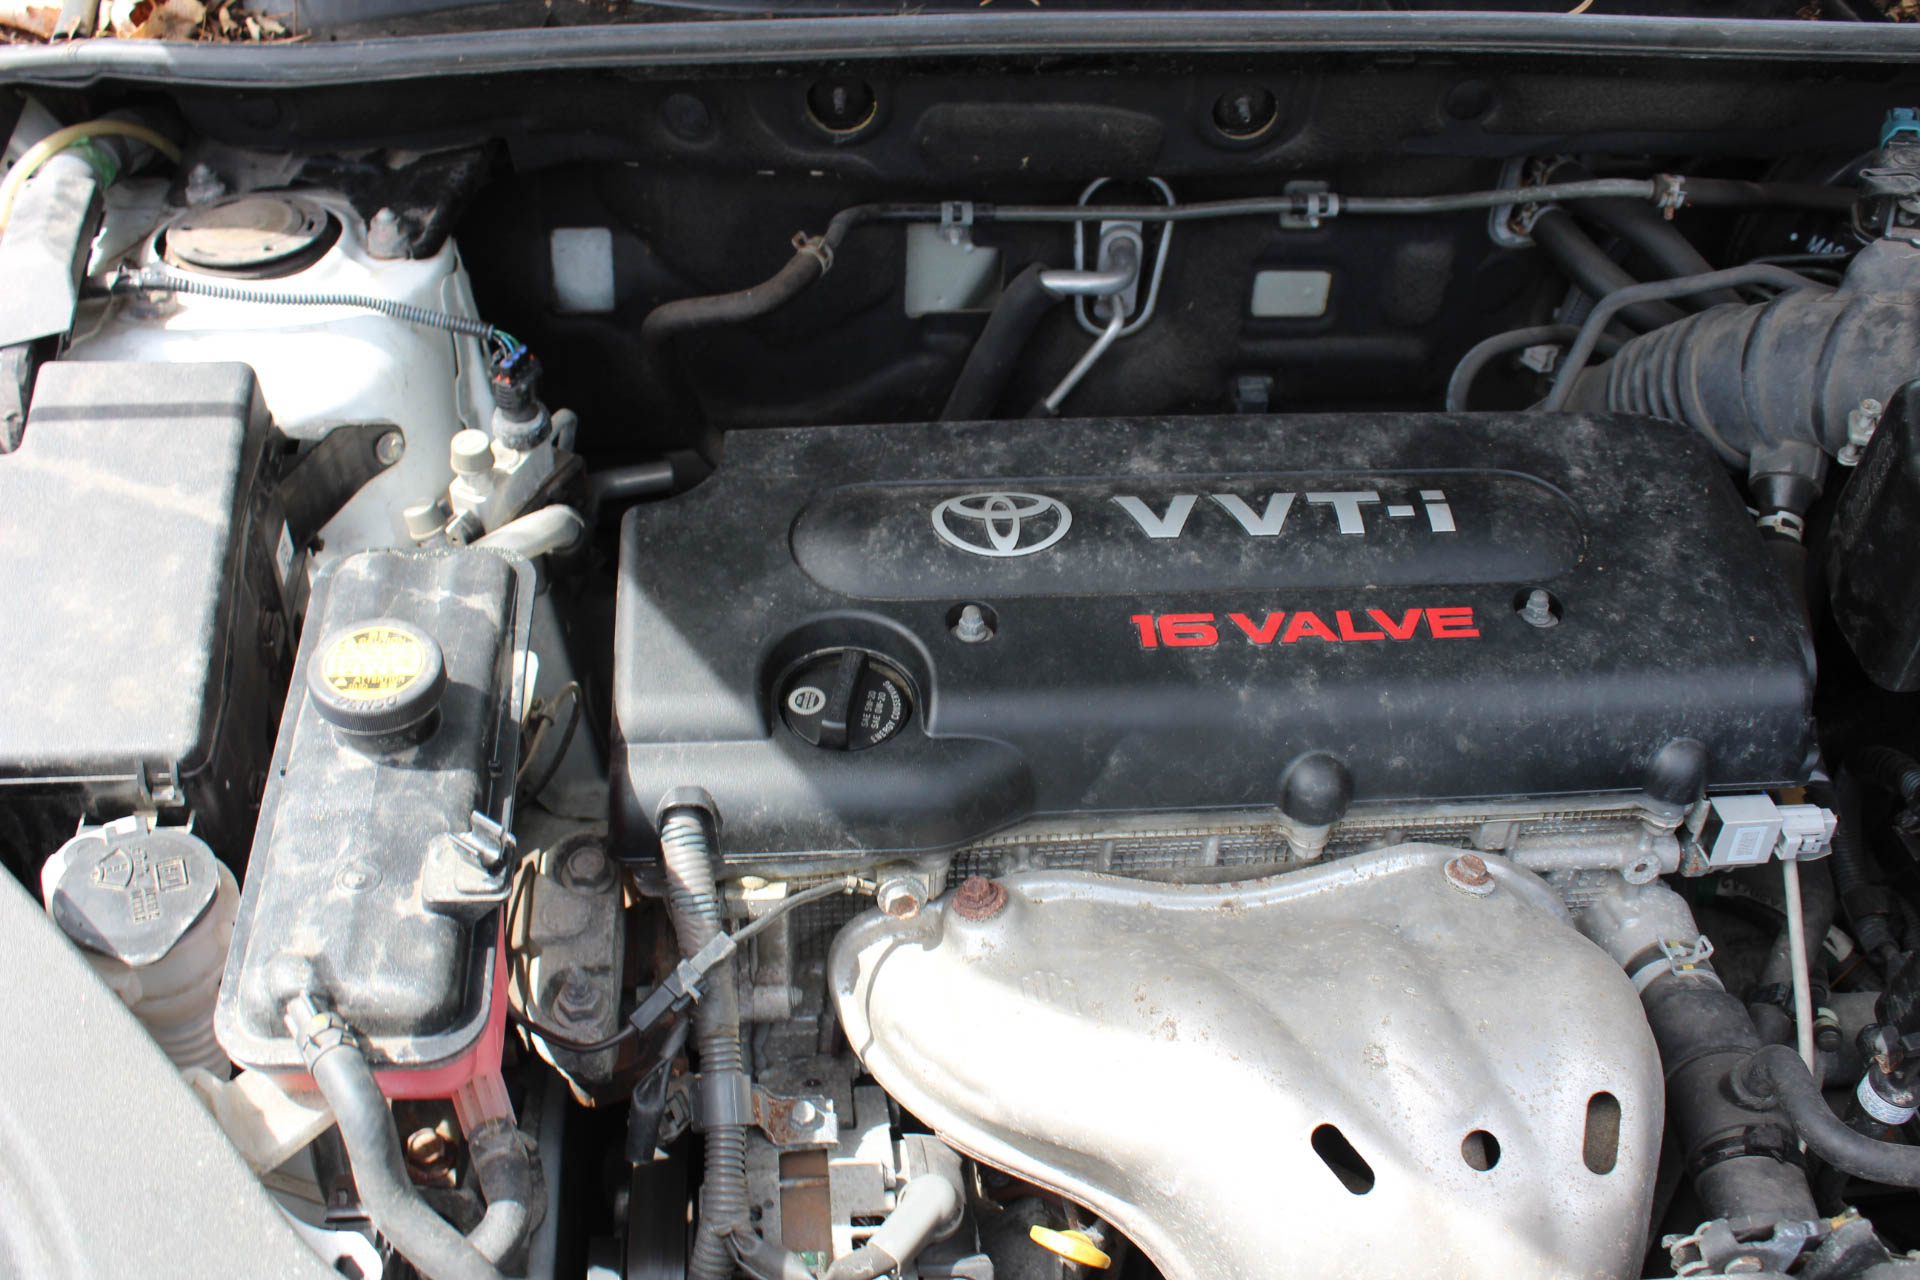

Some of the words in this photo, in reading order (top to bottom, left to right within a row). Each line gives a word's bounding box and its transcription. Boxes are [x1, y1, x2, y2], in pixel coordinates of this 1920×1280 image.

[1113, 490, 1456, 538] VVT-i
[1131, 613, 1219, 648] 16
[1227, 607, 1480, 644] VALVE
[335, 695, 398, 712] DENSO
[861, 713, 871, 728] SAE
[870, 714, 881, 729] SAE
[870, 719, 895, 743] ENERGY
